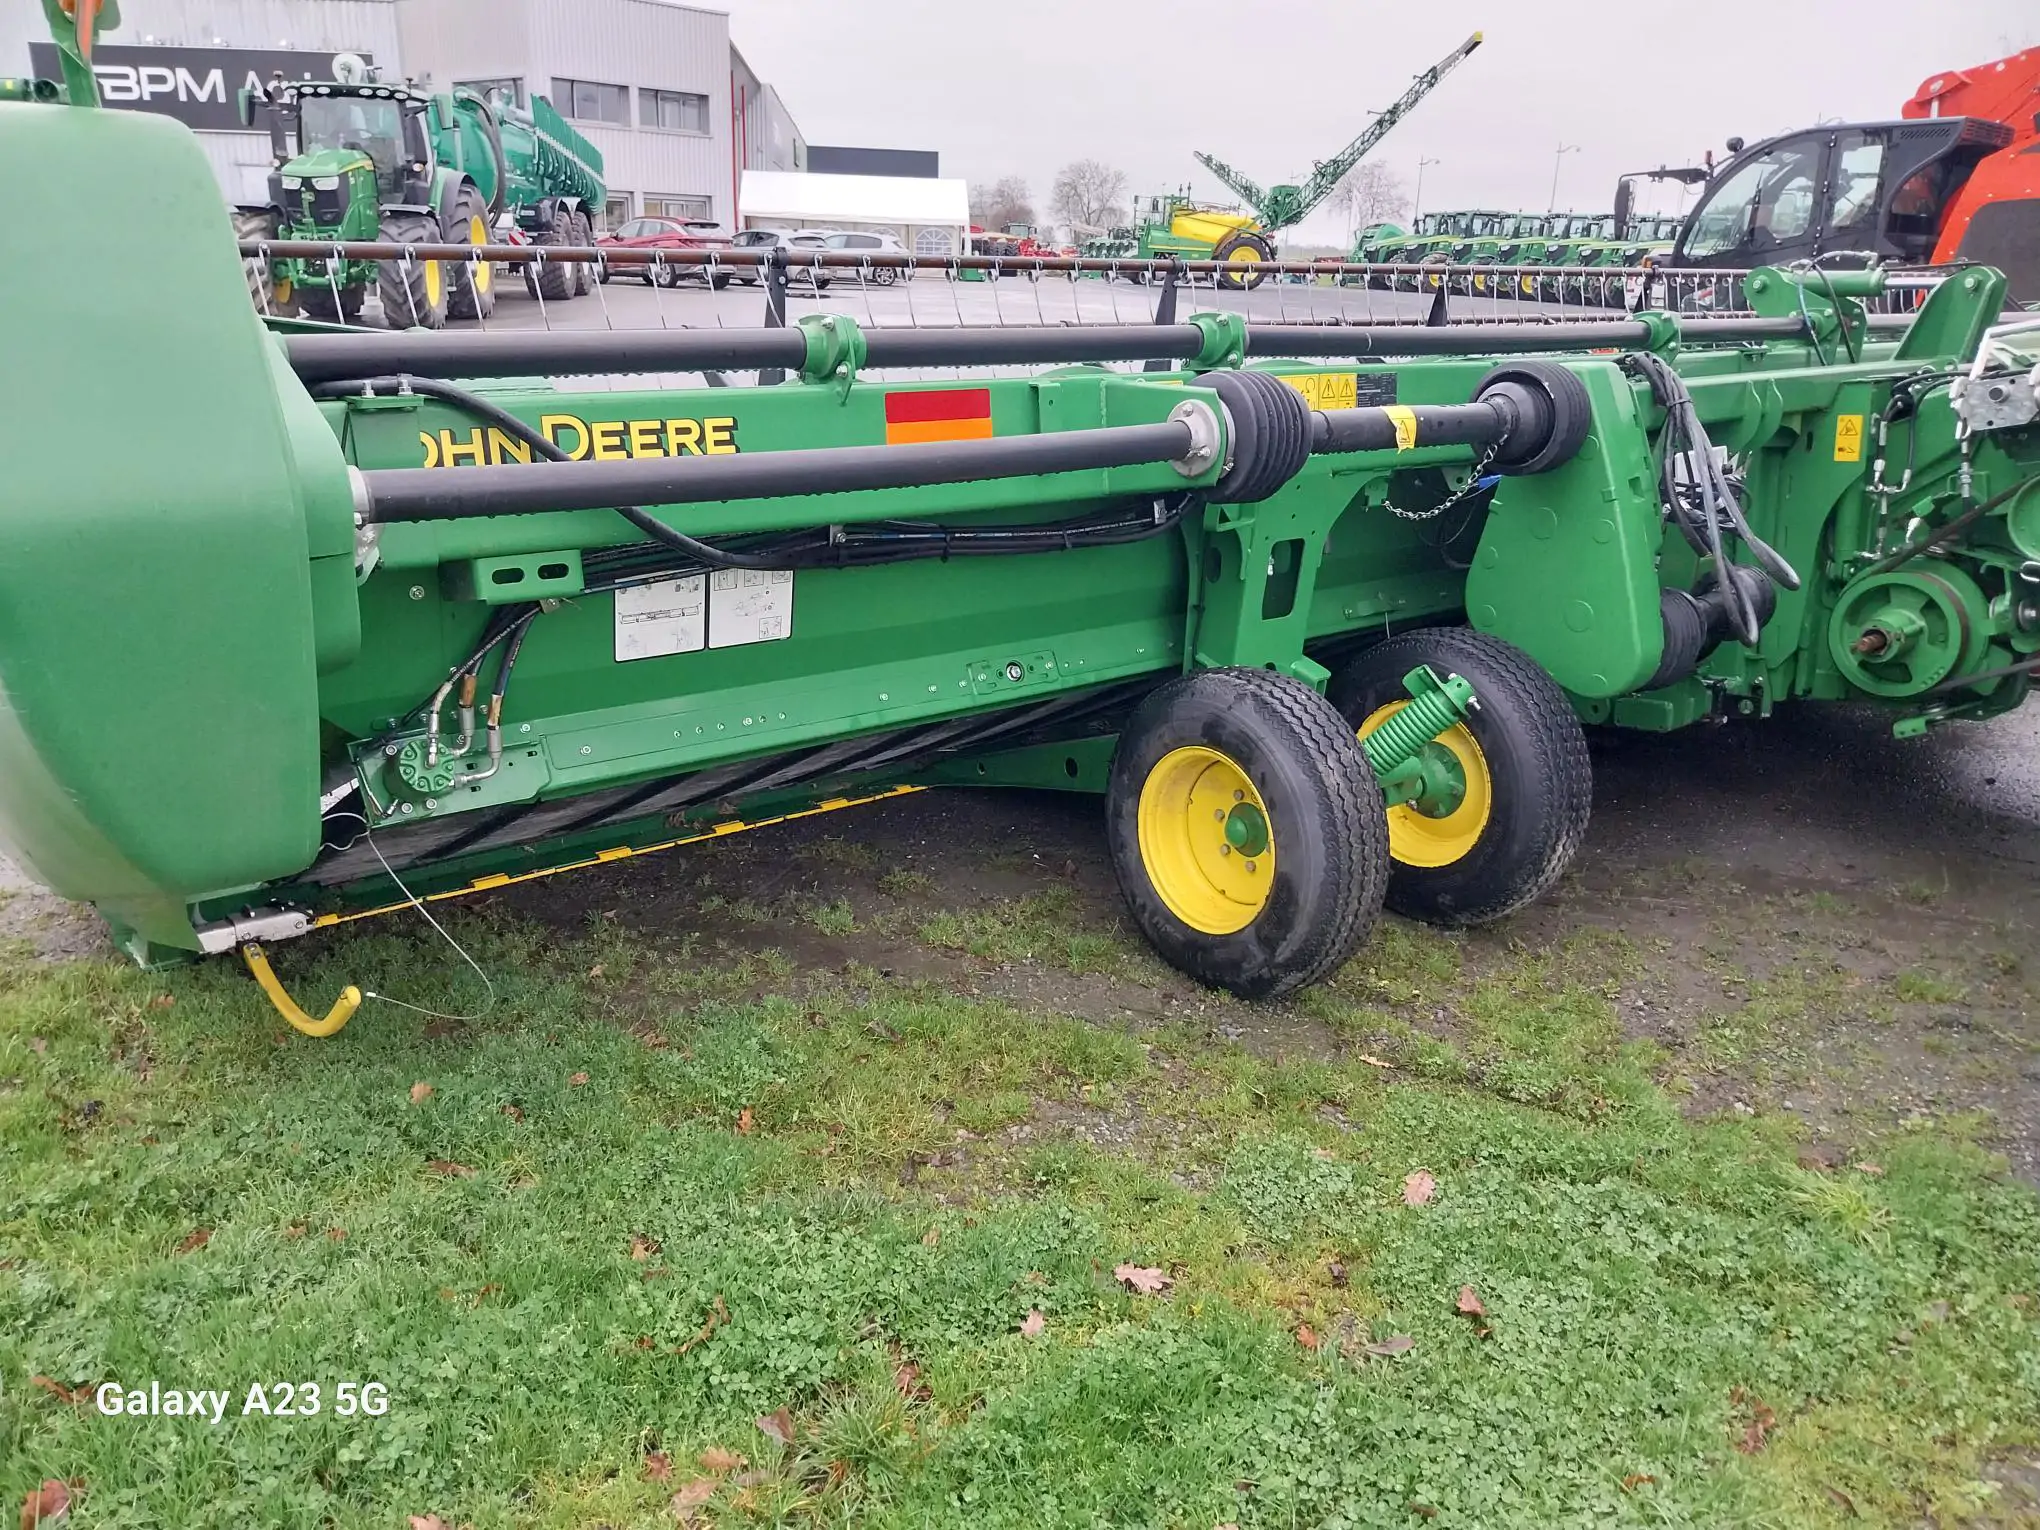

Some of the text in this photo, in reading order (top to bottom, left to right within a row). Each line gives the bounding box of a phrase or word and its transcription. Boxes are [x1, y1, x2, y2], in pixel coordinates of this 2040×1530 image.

[94, 64, 312, 106] BPM Ag
[540, 413, 739, 463] DEERE
